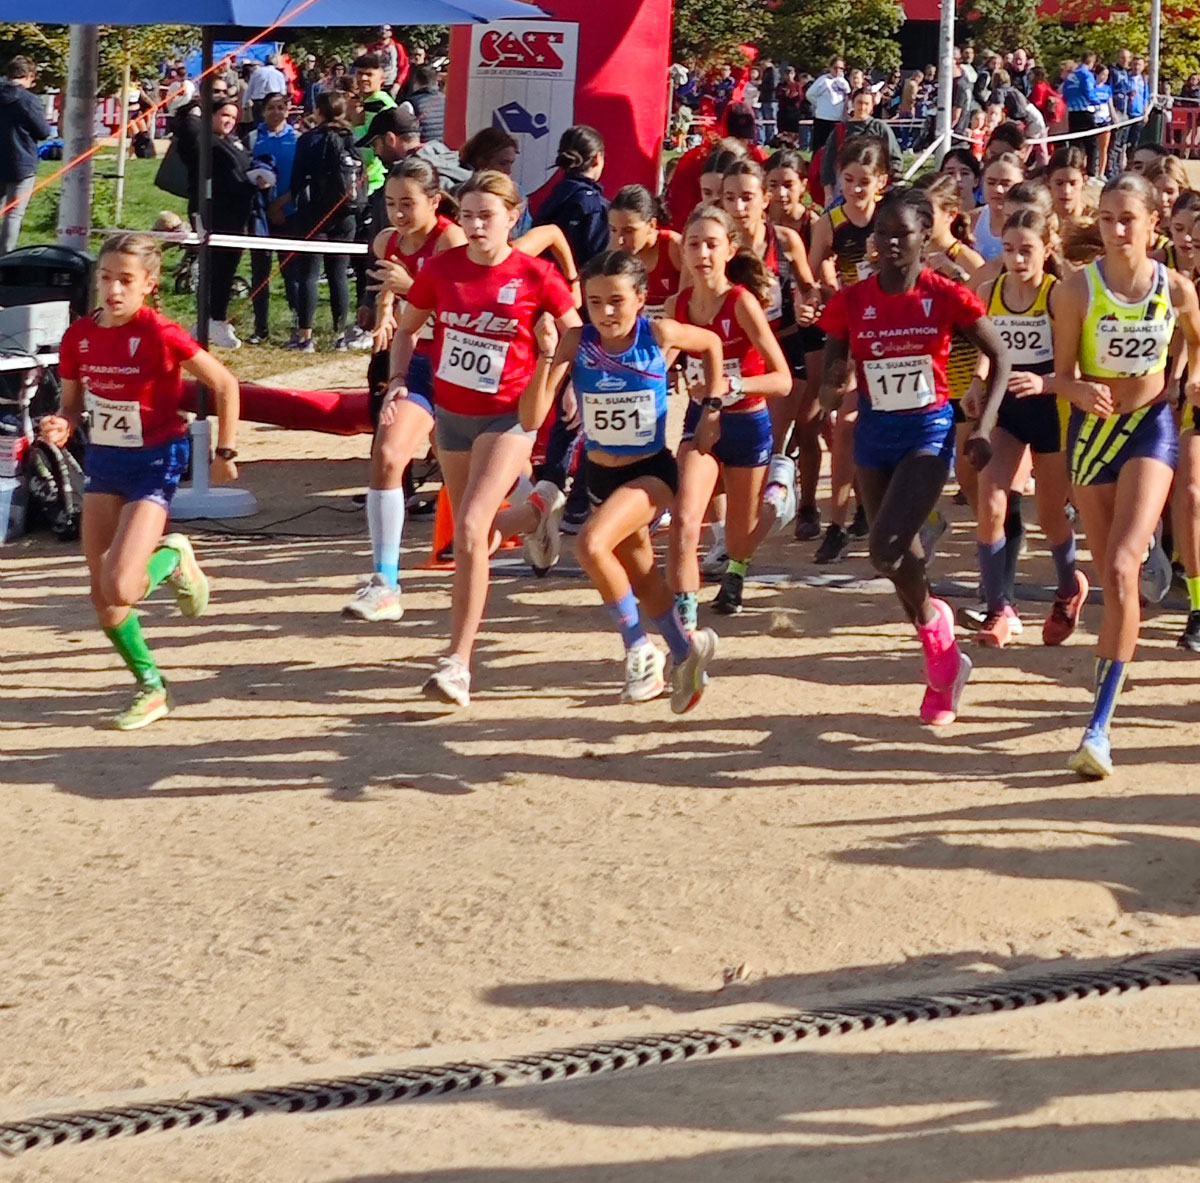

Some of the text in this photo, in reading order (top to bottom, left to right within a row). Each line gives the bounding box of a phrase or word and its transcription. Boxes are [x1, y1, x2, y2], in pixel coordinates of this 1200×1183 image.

[879, 327, 938, 338] MARATHON
[1108, 337, 1157, 359] 522
[449, 346, 492, 376] 500
[877, 370, 923, 396] 177
[594, 409, 642, 432] 551
